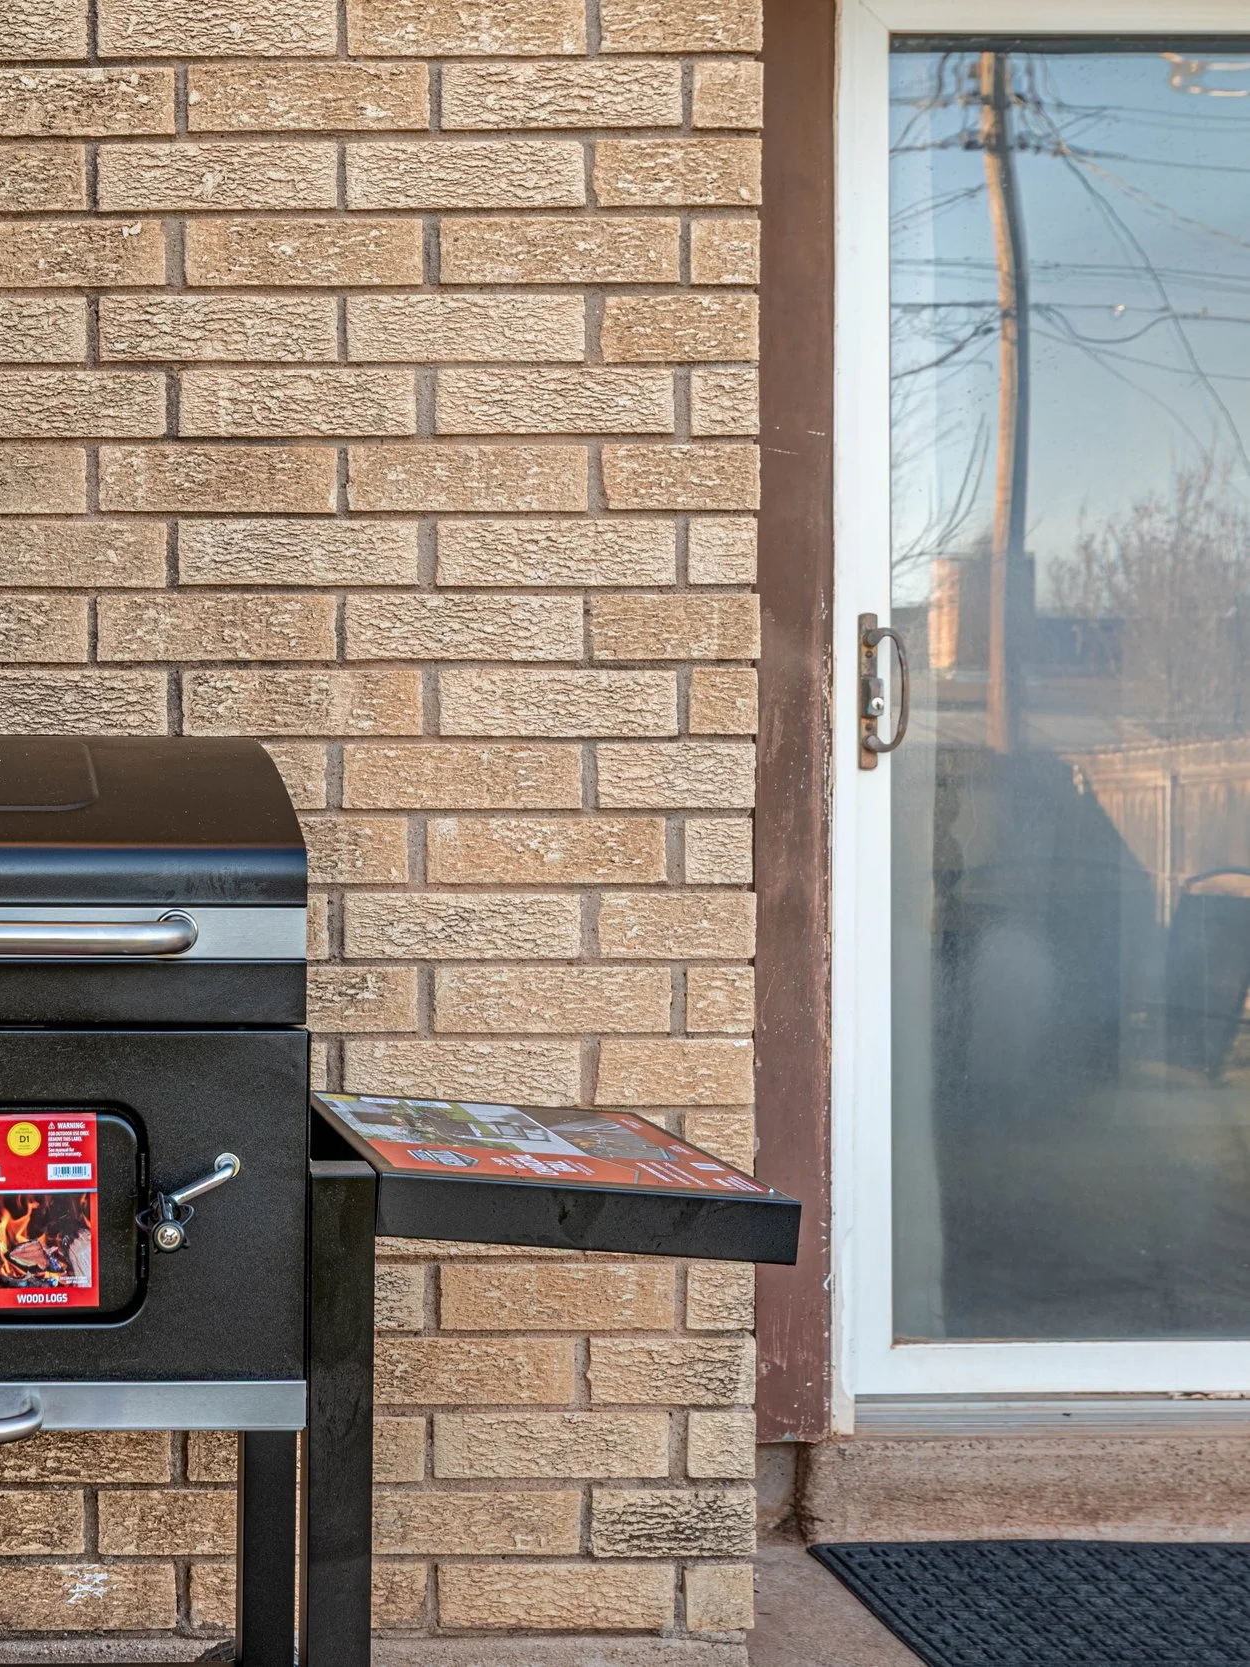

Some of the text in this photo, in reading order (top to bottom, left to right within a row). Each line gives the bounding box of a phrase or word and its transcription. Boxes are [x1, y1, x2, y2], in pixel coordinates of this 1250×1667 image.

[19, 1135, 30, 1143] D1
[17, 1293, 68, 1304] WOOD LOGS
